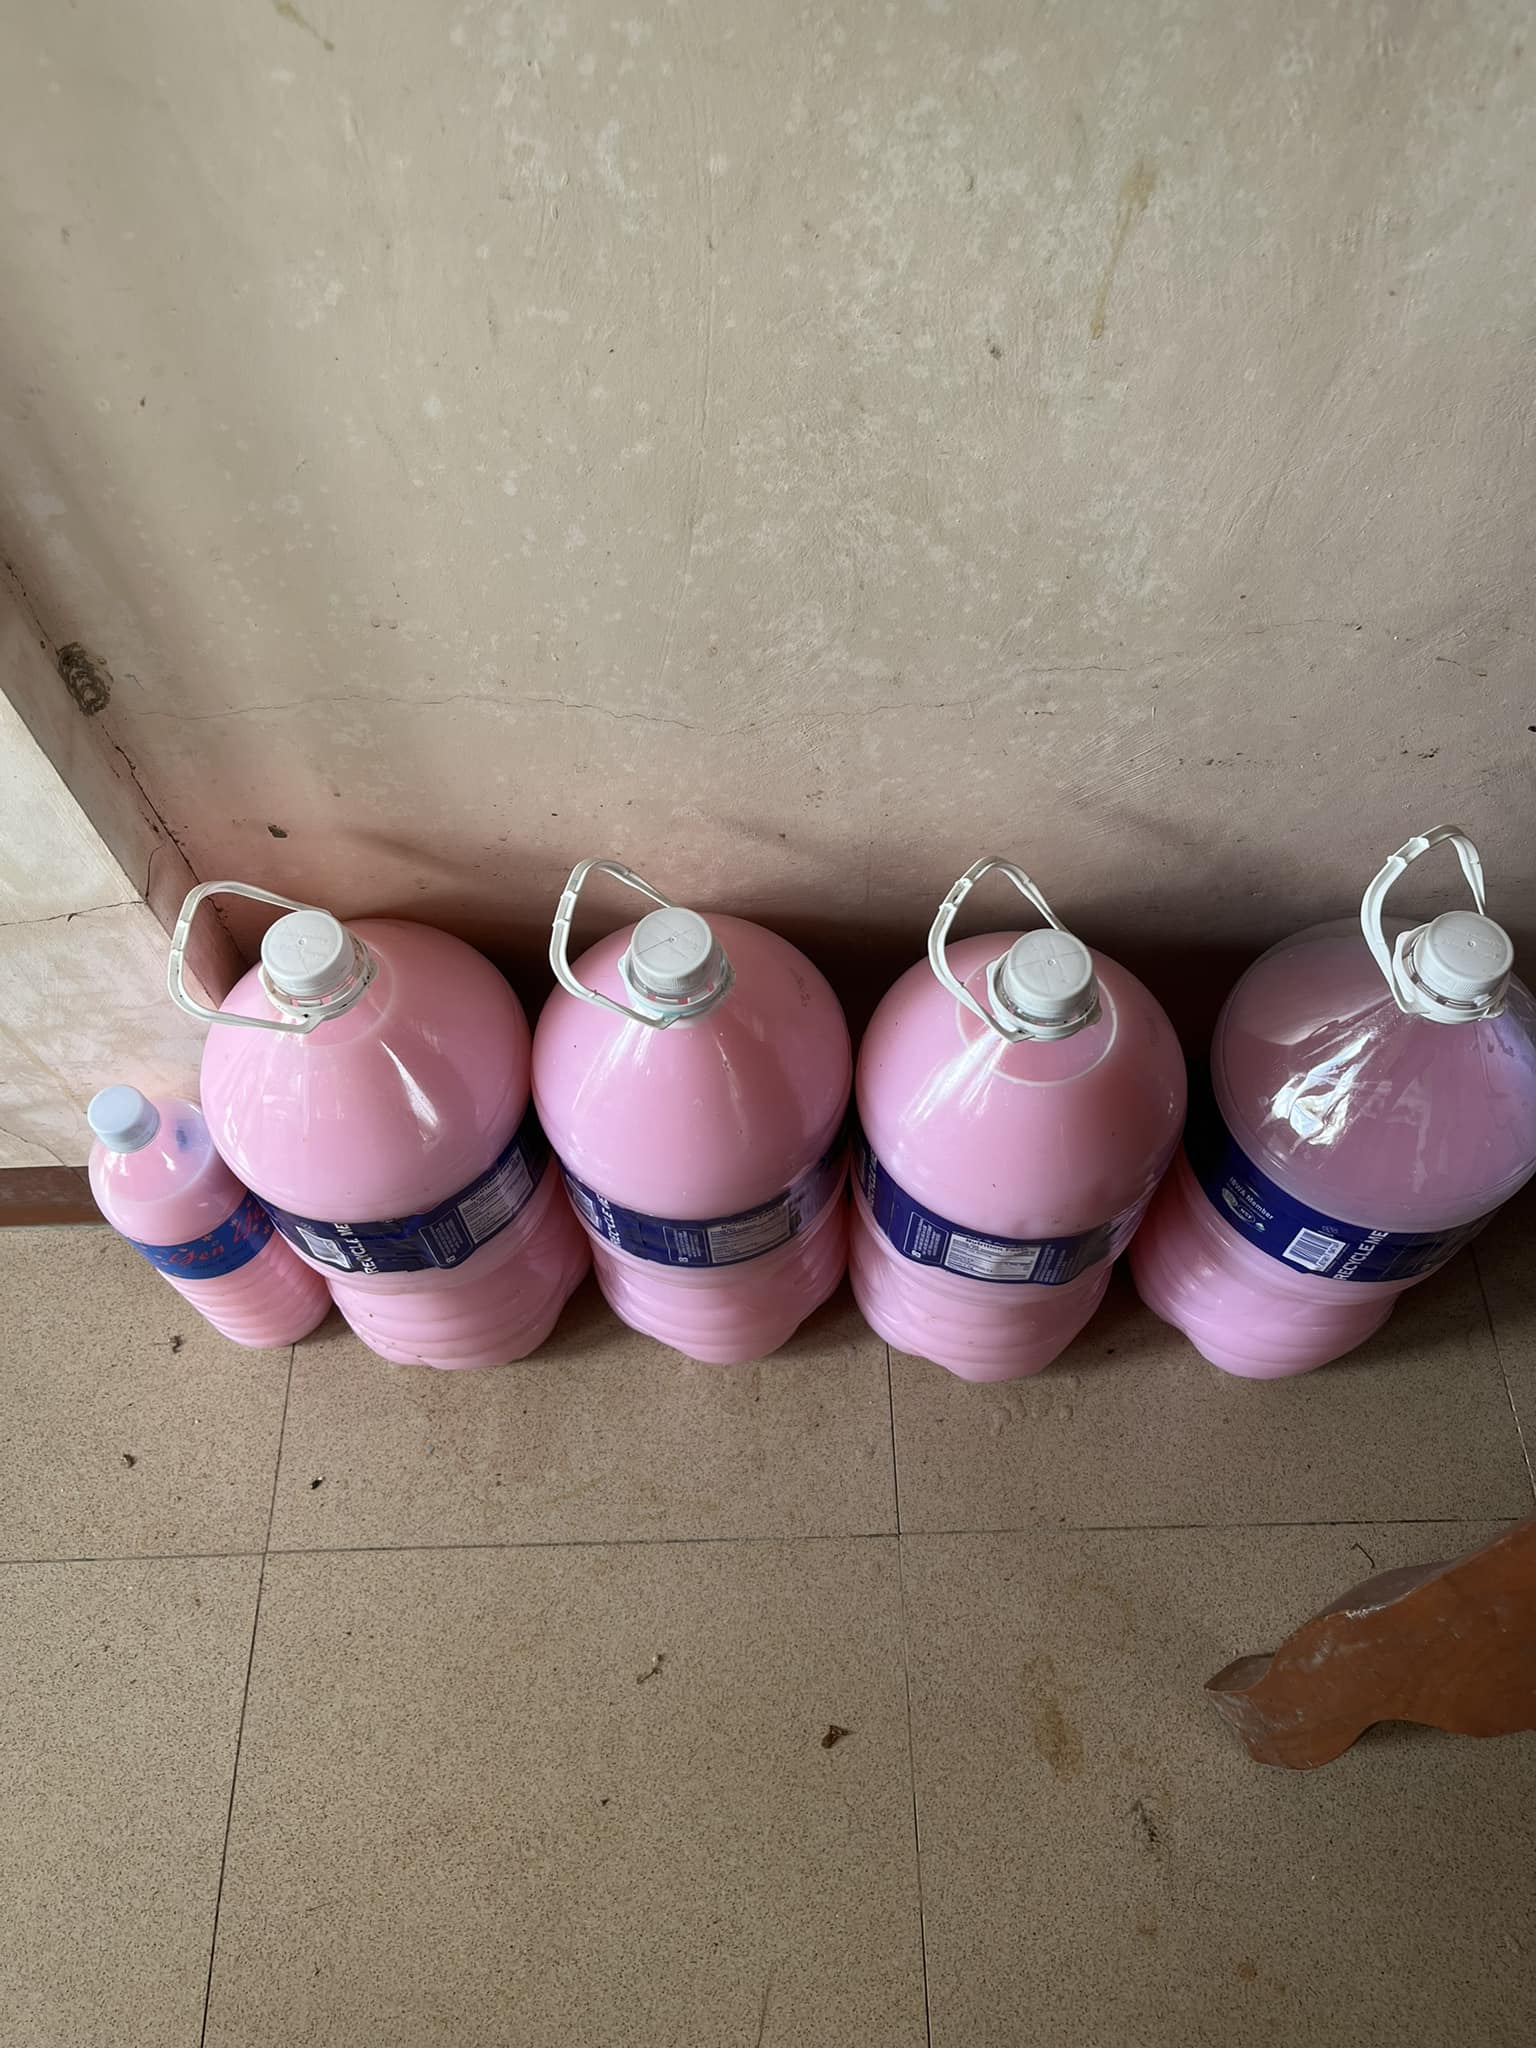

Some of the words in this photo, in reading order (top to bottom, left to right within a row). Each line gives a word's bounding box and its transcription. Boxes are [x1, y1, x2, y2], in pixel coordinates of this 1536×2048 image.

[1245, 1194, 1275, 1220] Member
[333, 1222, 354, 1237] ME
[344, 1237, 380, 1275] RECYCLE
[1333, 1242, 1376, 1280] RECYCLE
[1363, 1230, 1389, 1246] ME
